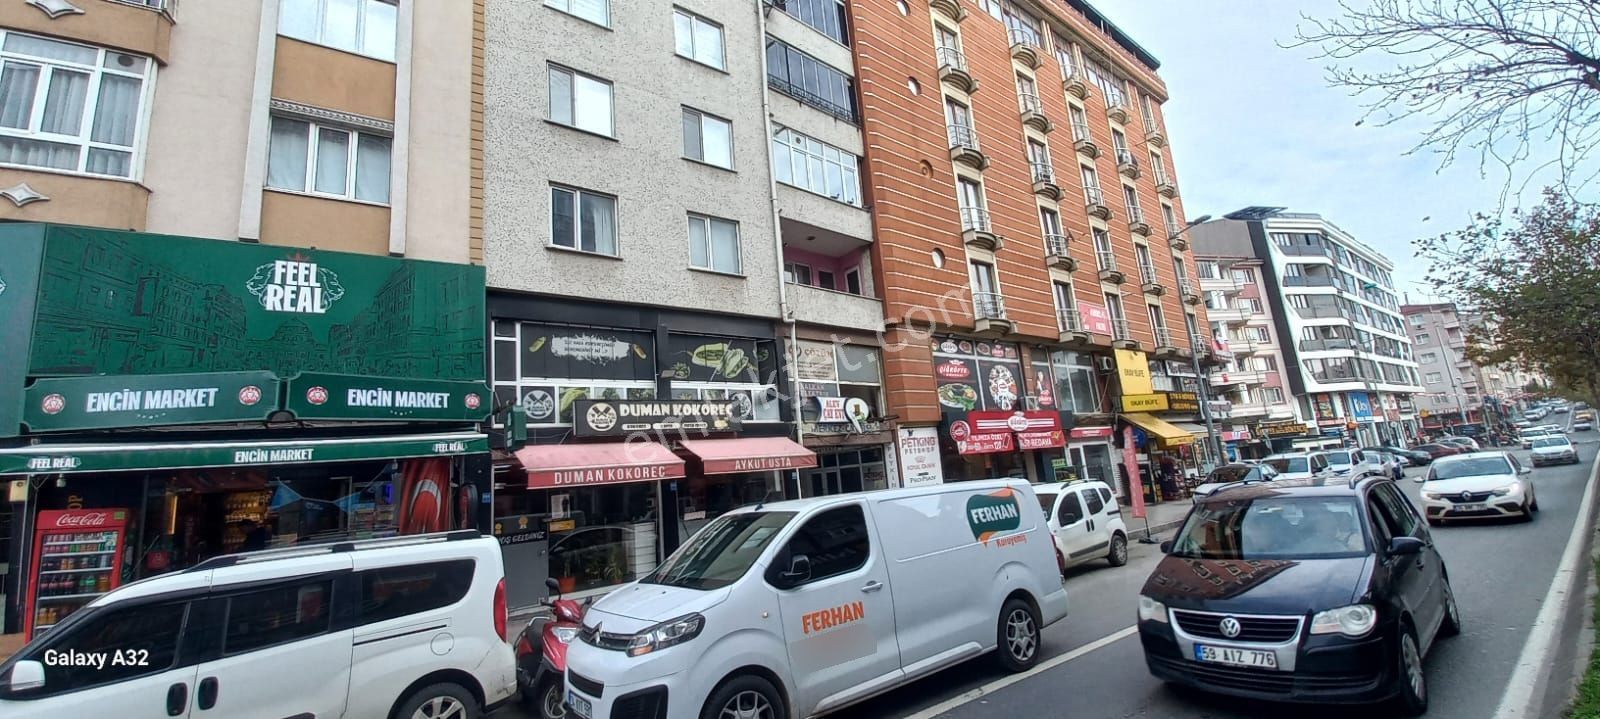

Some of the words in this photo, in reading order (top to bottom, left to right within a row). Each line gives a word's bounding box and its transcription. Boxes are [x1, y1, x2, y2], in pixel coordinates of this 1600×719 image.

[274, 260, 321, 287] FEEL
[265, 284, 326, 313] REAL
[144, 388, 219, 410] MARKET
[395, 390, 450, 409] MARKET
[619, 404, 671, 417] DUMAN
[270, 448, 314, 461] MARKET
[434, 442, 449, 452] FEEL
[30, 458, 50, 469] FEEL
[53, 456, 78, 468] REAL
[734, 458, 766, 470] AYKUT
[768, 457, 792, 469] USTA
[554, 468, 604, 485] DUMAN
[970, 503, 1018, 524] FERHAN
[801, 601, 865, 634] FERHAN
[1202, 647, 1216, 659] 59
[1250, 651, 1275, 666] 776
